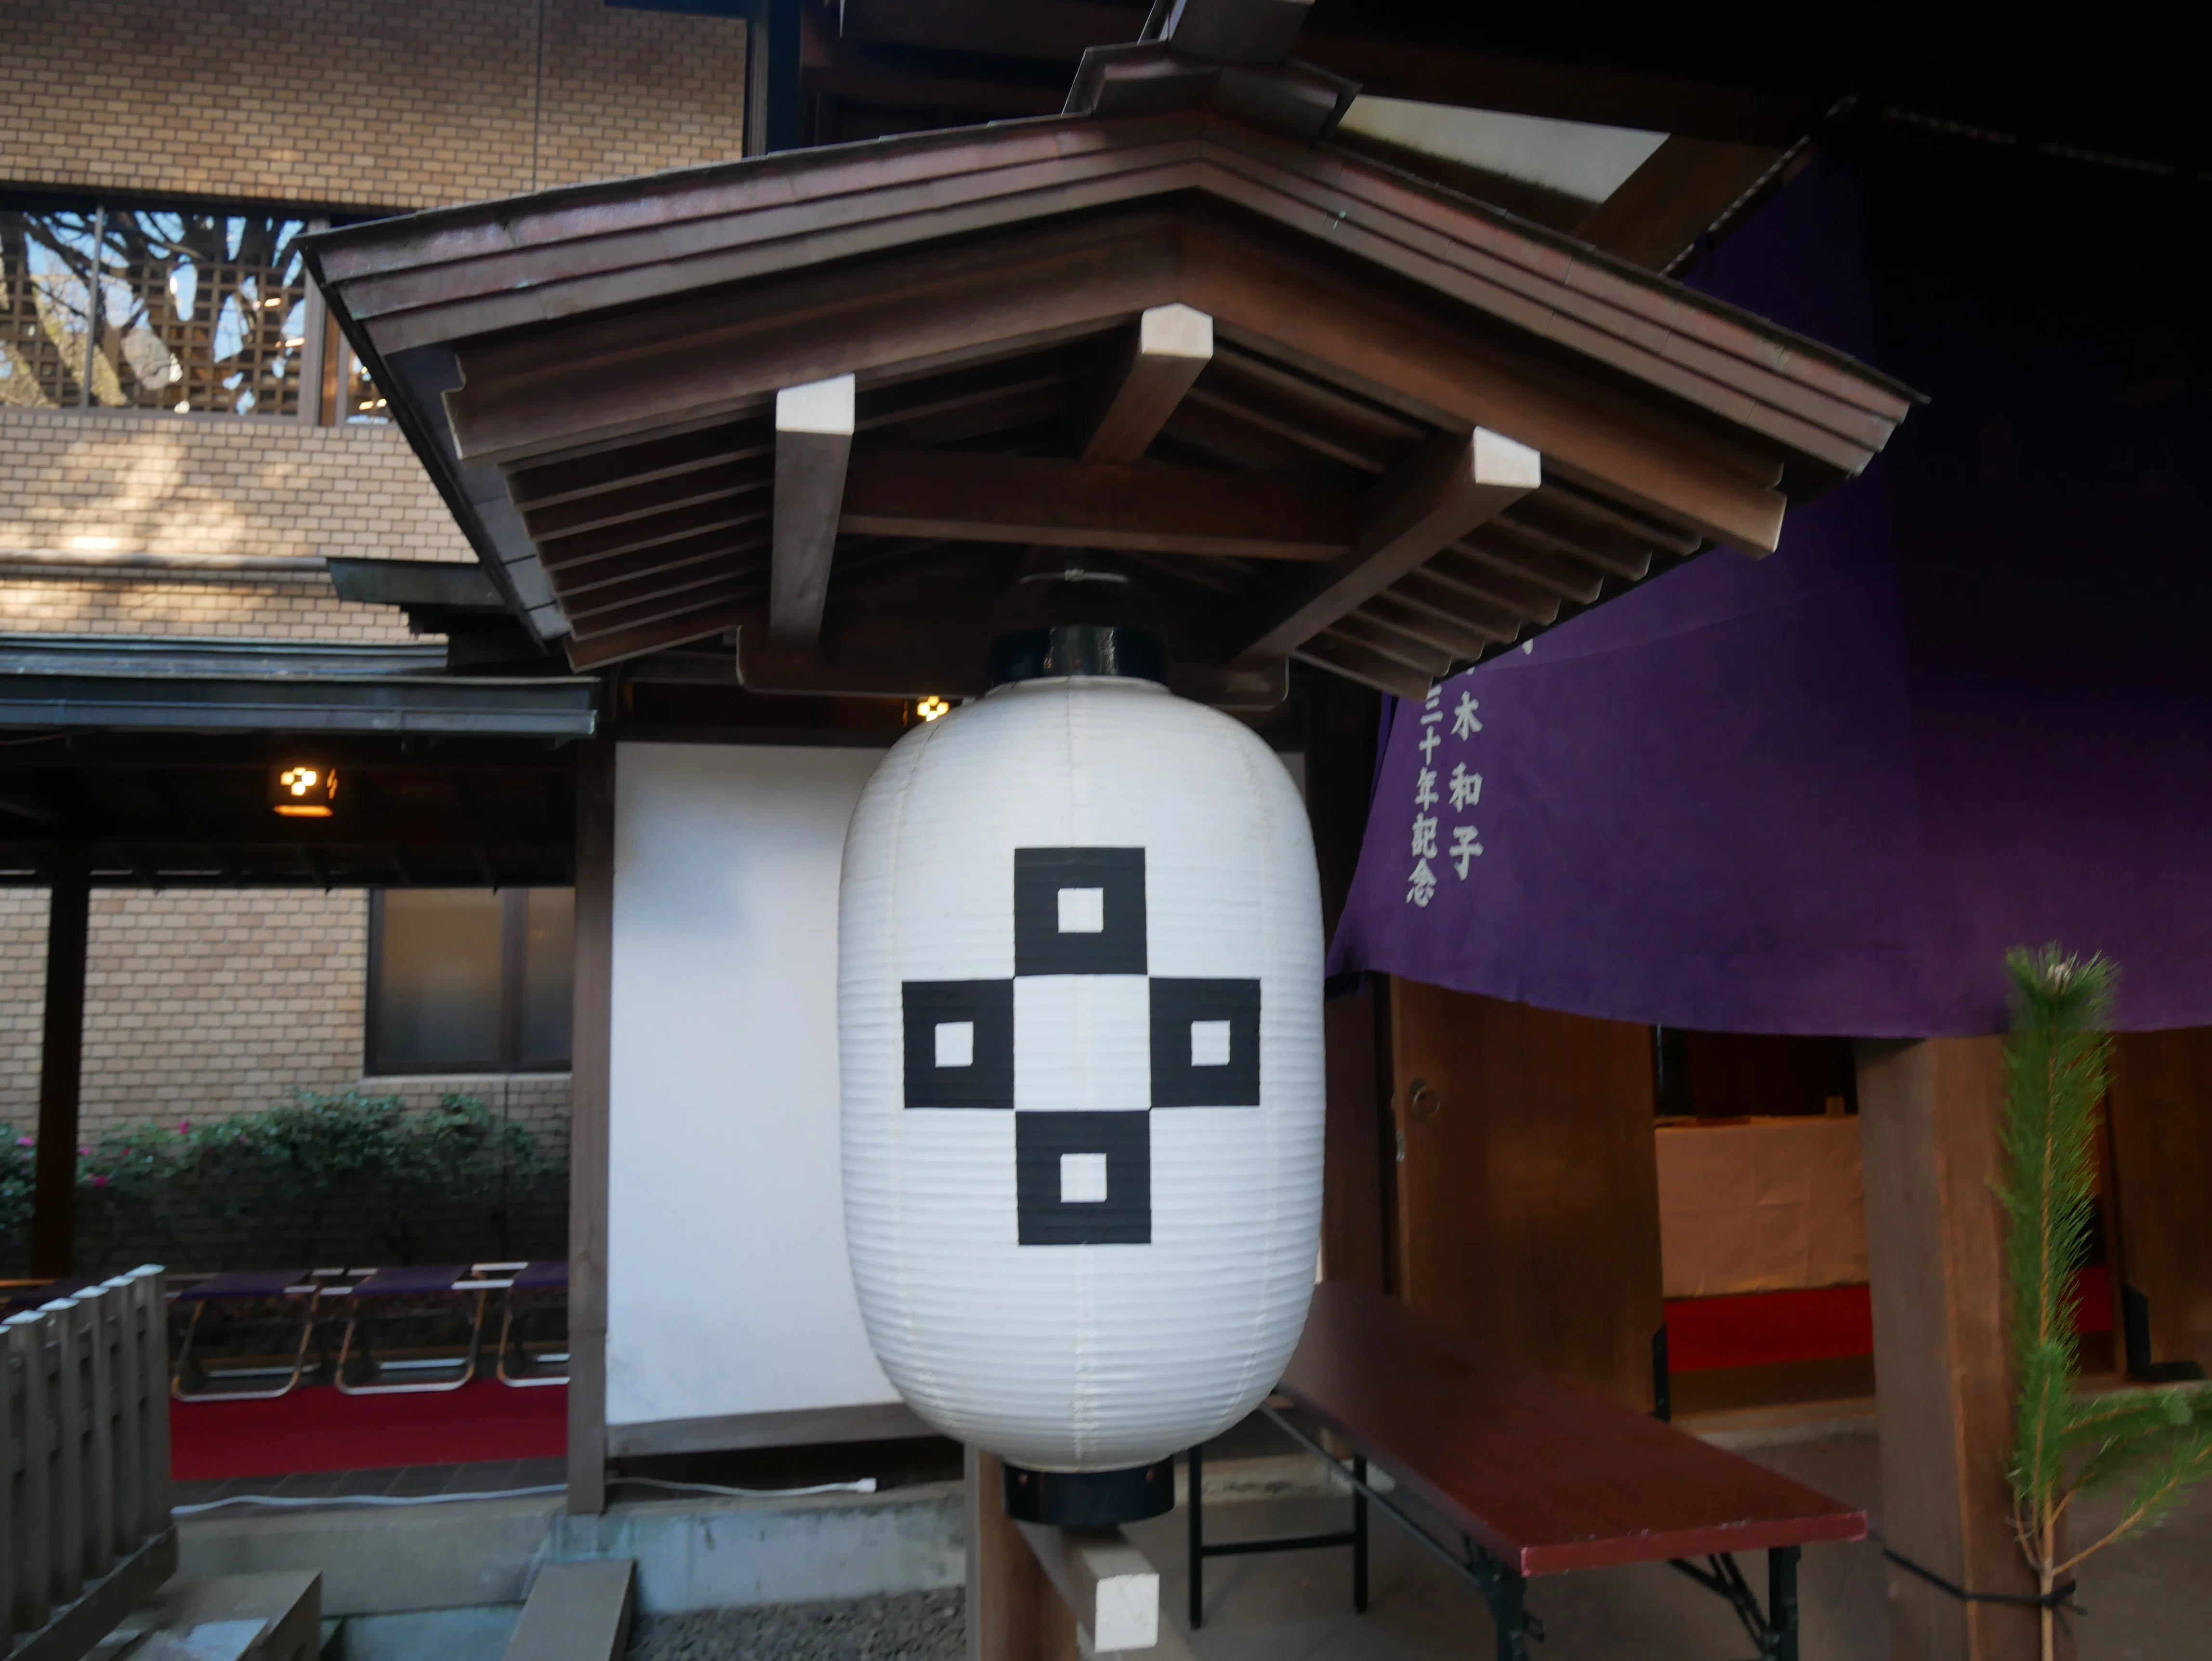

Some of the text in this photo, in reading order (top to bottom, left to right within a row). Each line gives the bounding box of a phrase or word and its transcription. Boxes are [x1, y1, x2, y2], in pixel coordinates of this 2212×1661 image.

[1406, 684, 1444, 908] 三十年記念
[1449, 667, 1484, 881] 木和子
